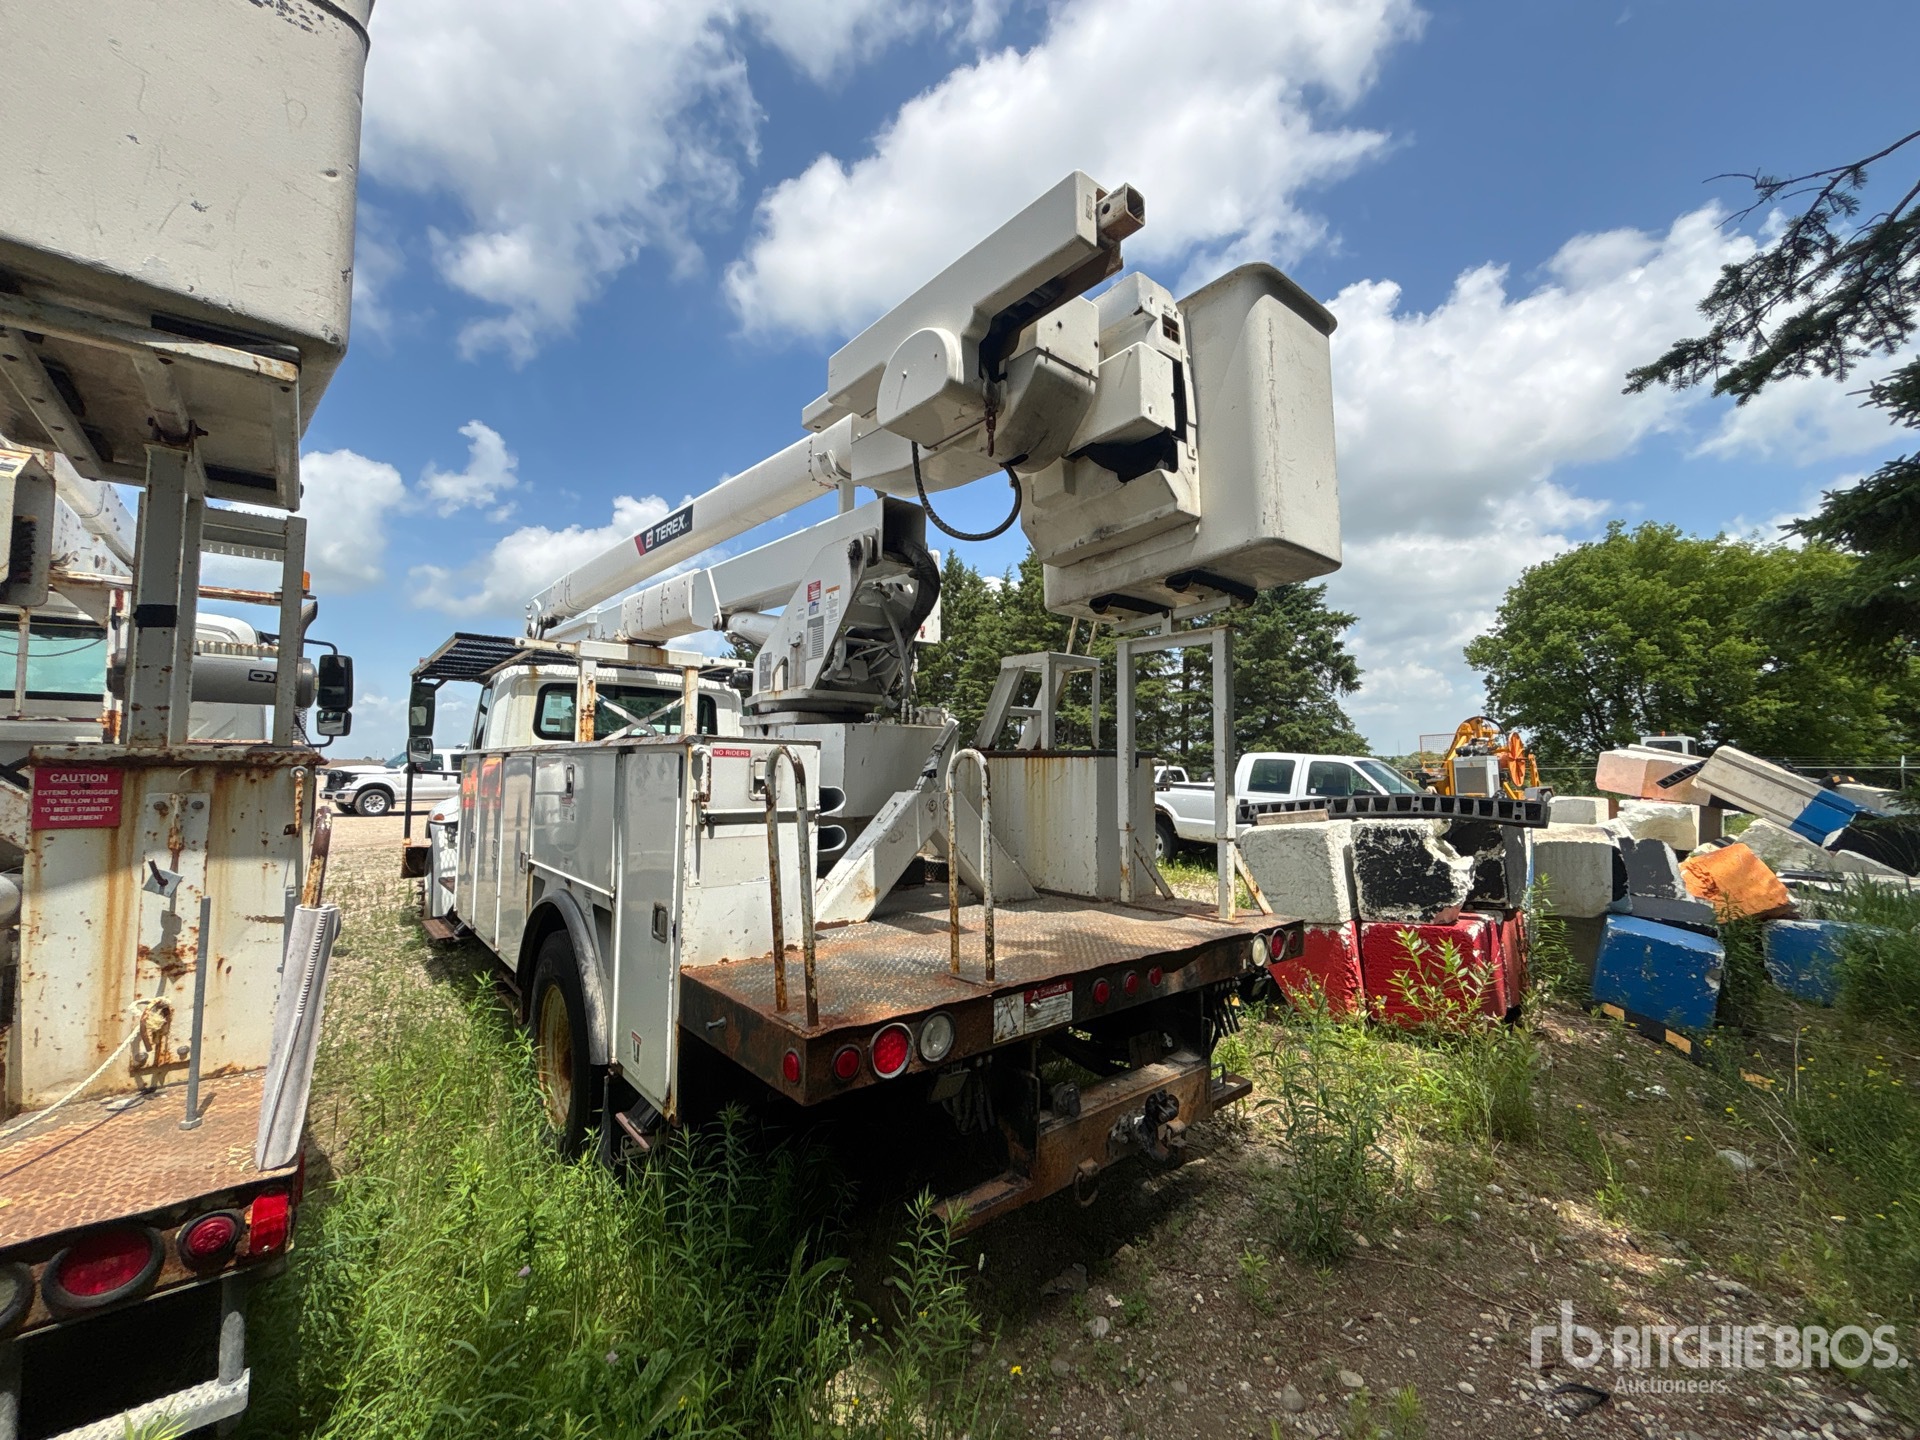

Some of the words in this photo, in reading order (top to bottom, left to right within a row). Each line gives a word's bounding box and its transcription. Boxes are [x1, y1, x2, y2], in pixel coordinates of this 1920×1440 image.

[656, 514, 685, 542] TEREX
[725, 749, 749, 757] RIDERS
[49, 773, 109, 783] CAUTION
[49, 814, 104, 822] REQUIREMENT
[1040, 983, 1067, 997] DANGER
